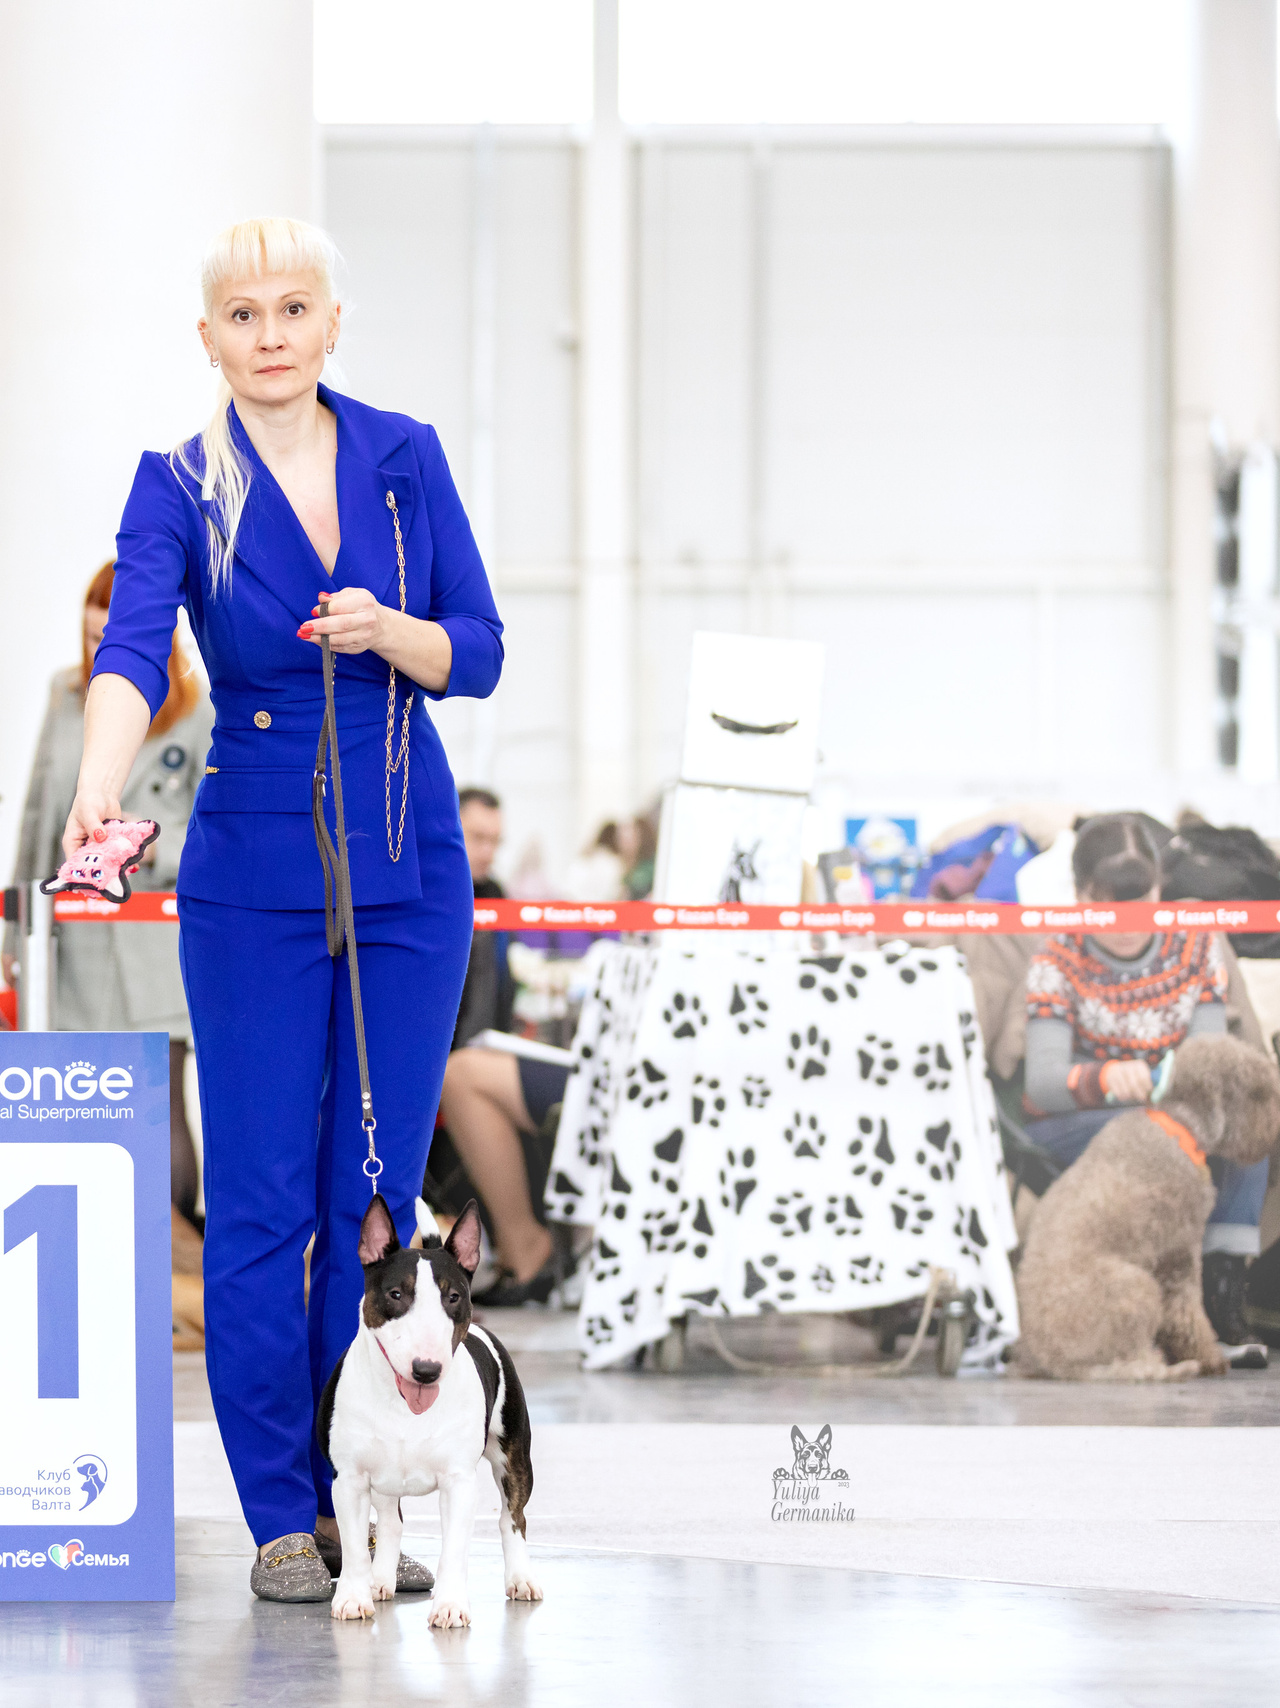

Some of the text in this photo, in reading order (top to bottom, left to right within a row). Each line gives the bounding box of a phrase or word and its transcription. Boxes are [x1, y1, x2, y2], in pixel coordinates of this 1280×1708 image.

[583, 907, 616, 925] Expo
[716, 908, 749, 926] Expo
[841, 910, 874, 927] Expo
[966, 911, 998, 928] Expo
[1083, 909, 1116, 926] Expo
[1216, 909, 1248, 926] Expo
[18, 1104, 134, 1122] Superpremium
[3, 1184, 79, 1399] 1
[37, 1469, 71, 1483] Клуб
[31, 1499, 71, 1511] Валта
[72, 1550, 130, 1567] Семья
